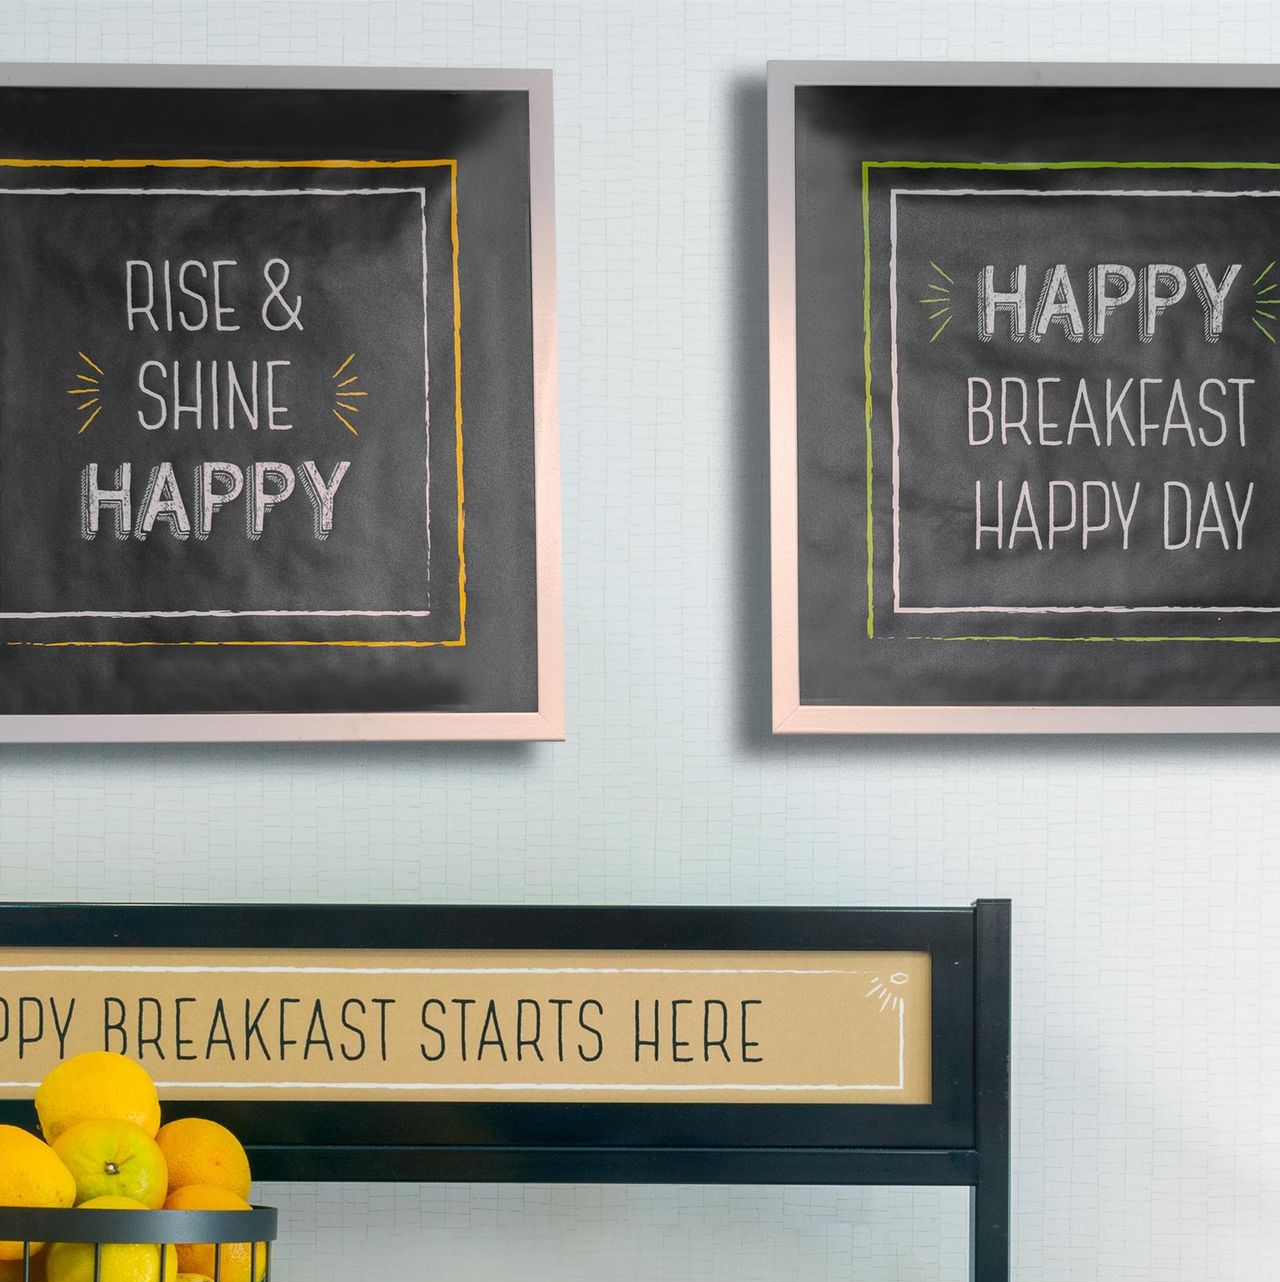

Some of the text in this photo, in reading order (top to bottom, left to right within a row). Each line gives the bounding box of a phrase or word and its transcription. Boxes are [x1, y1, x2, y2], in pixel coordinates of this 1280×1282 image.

[126, 258, 304, 331] RISE &
[977, 263, 1243, 343] HAPPY
[137, 359, 293, 430] SHINE
[967, 376, 1255, 447] BREAKFAST
[80, 460, 352, 541] HAPPY
[974, 480, 1254, 550] HAPPY DAY
[104, 996, 397, 1064] BREAKFAST
[420, 998, 607, 1065] STARTS
[635, 998, 765, 1065] HERE
